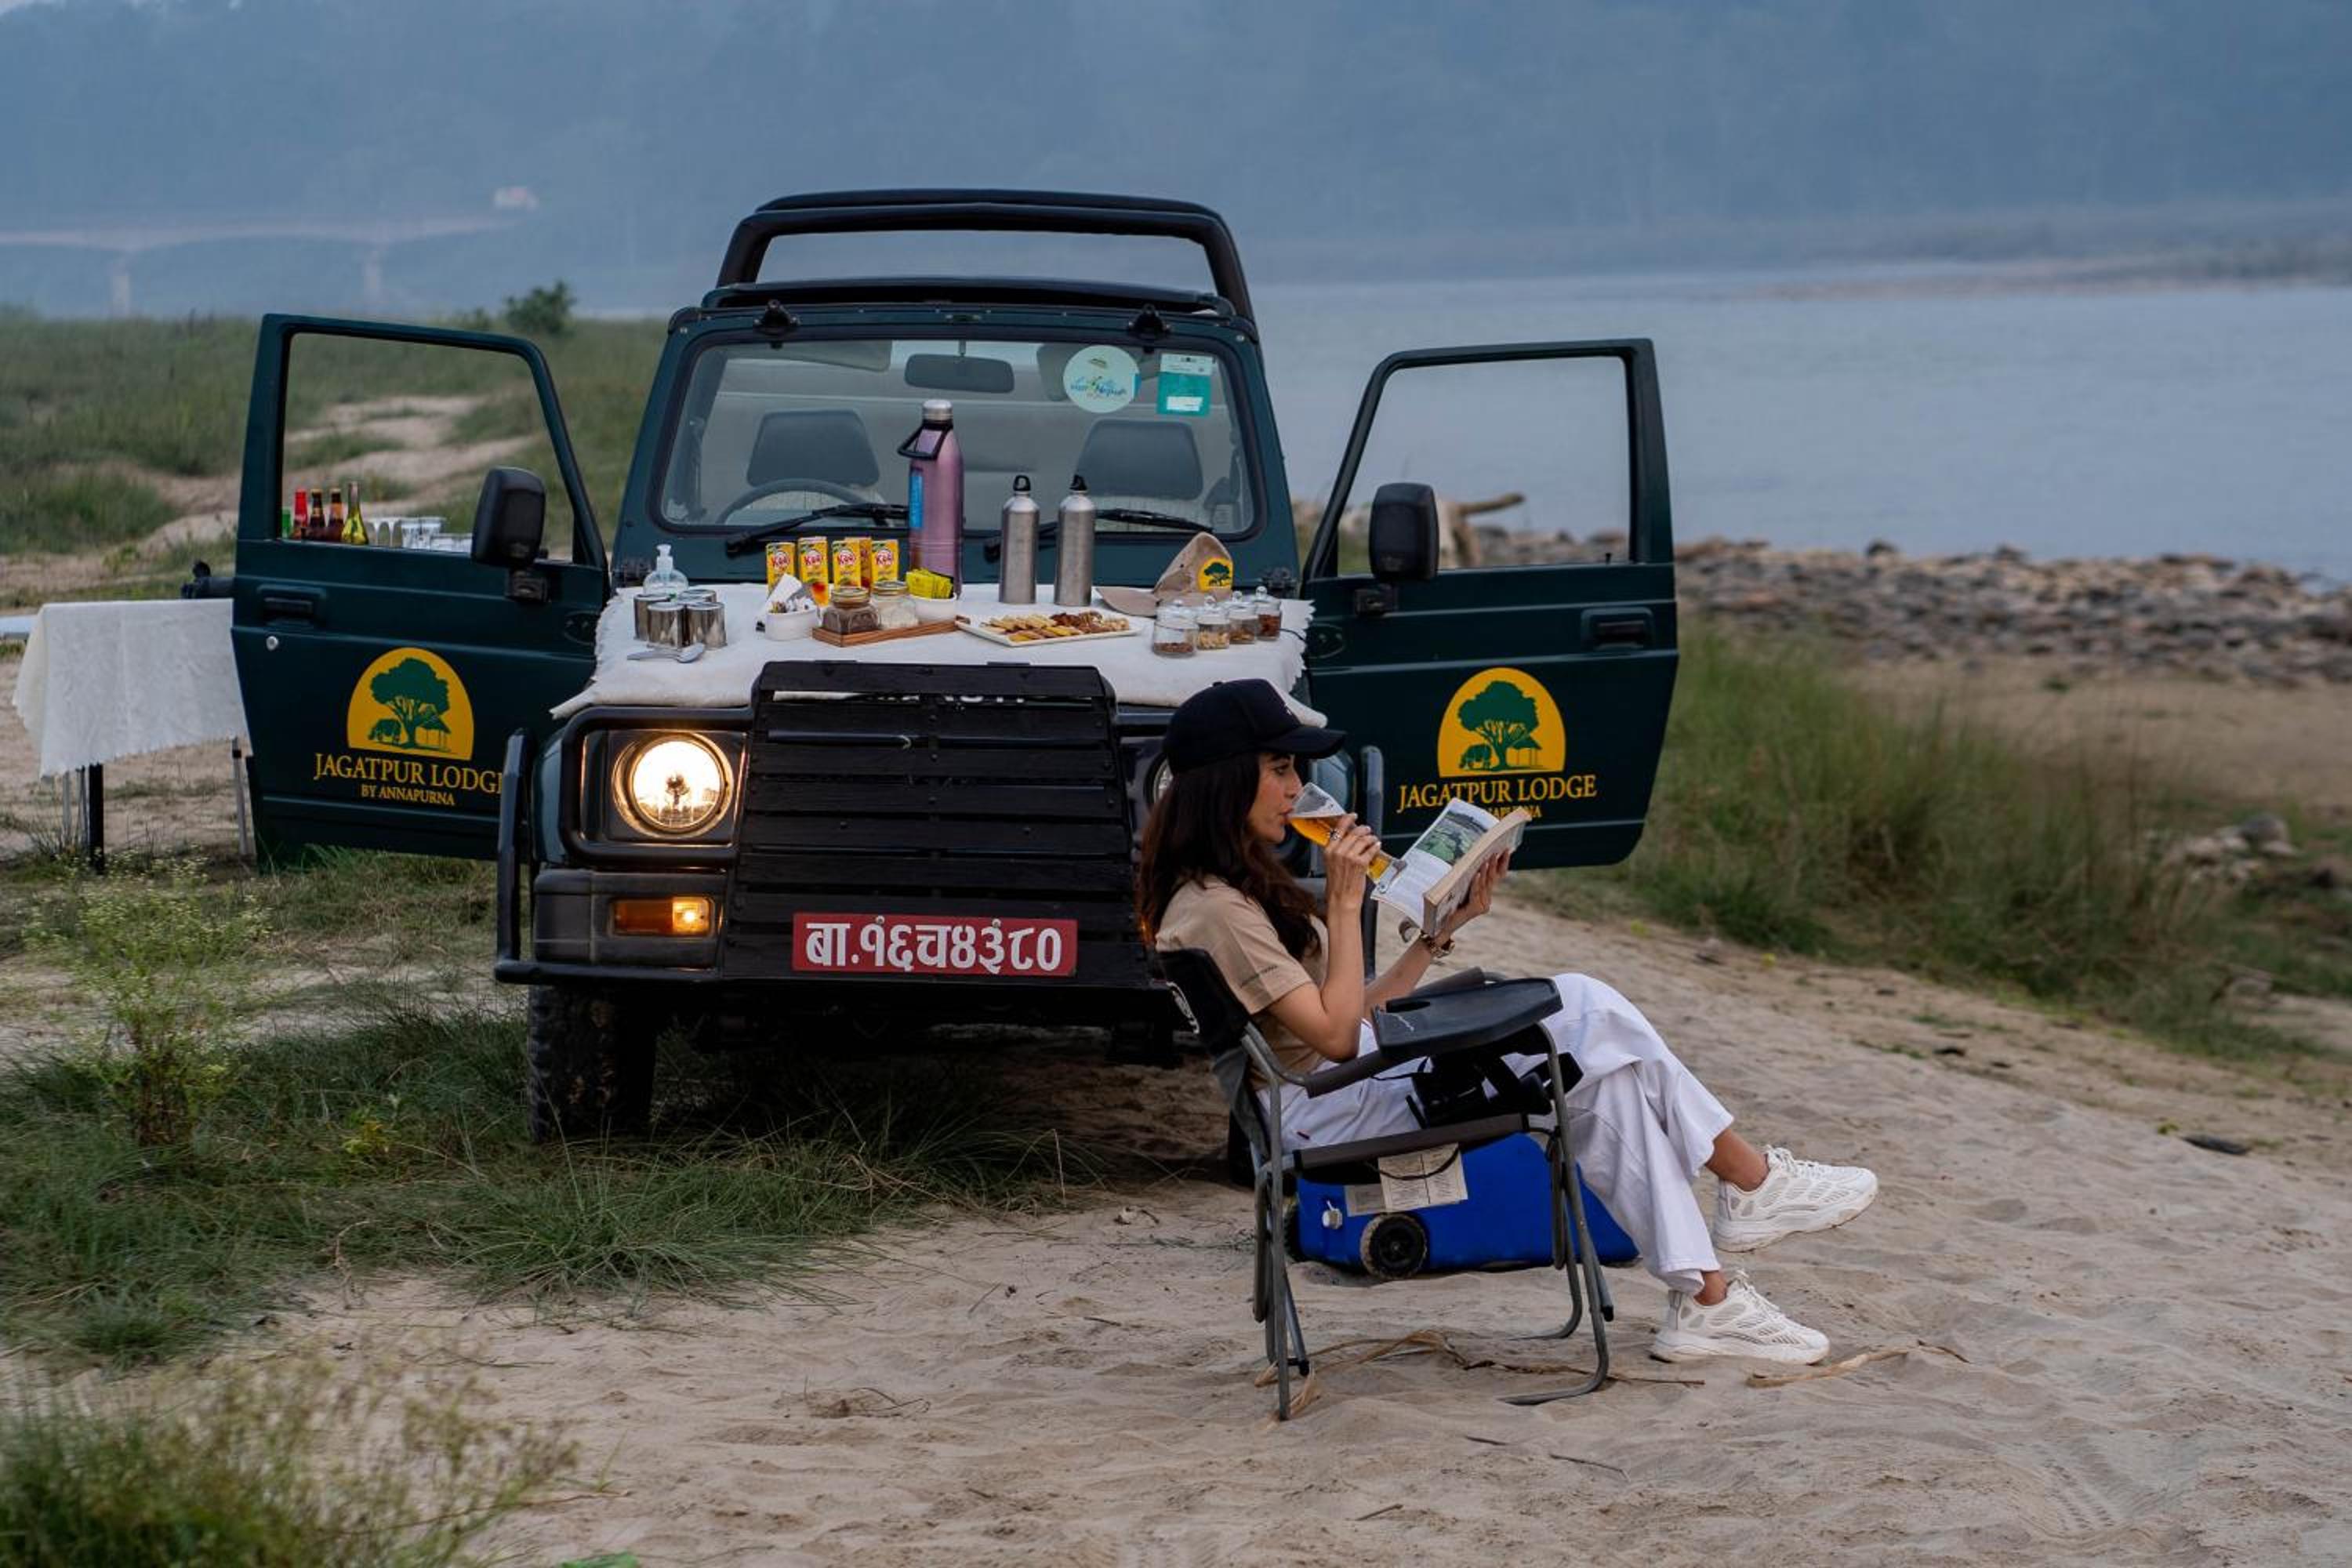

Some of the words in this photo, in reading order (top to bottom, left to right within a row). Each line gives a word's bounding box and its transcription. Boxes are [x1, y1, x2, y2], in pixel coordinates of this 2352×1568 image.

[314, 753, 426, 785] JAGATPUR
[361, 785, 376, 798] BY
[379, 786, 455, 806] ANNAPURNA
[1396, 779, 1512, 814] JAGATPUR
[1518, 775, 1598, 802] LODGE
